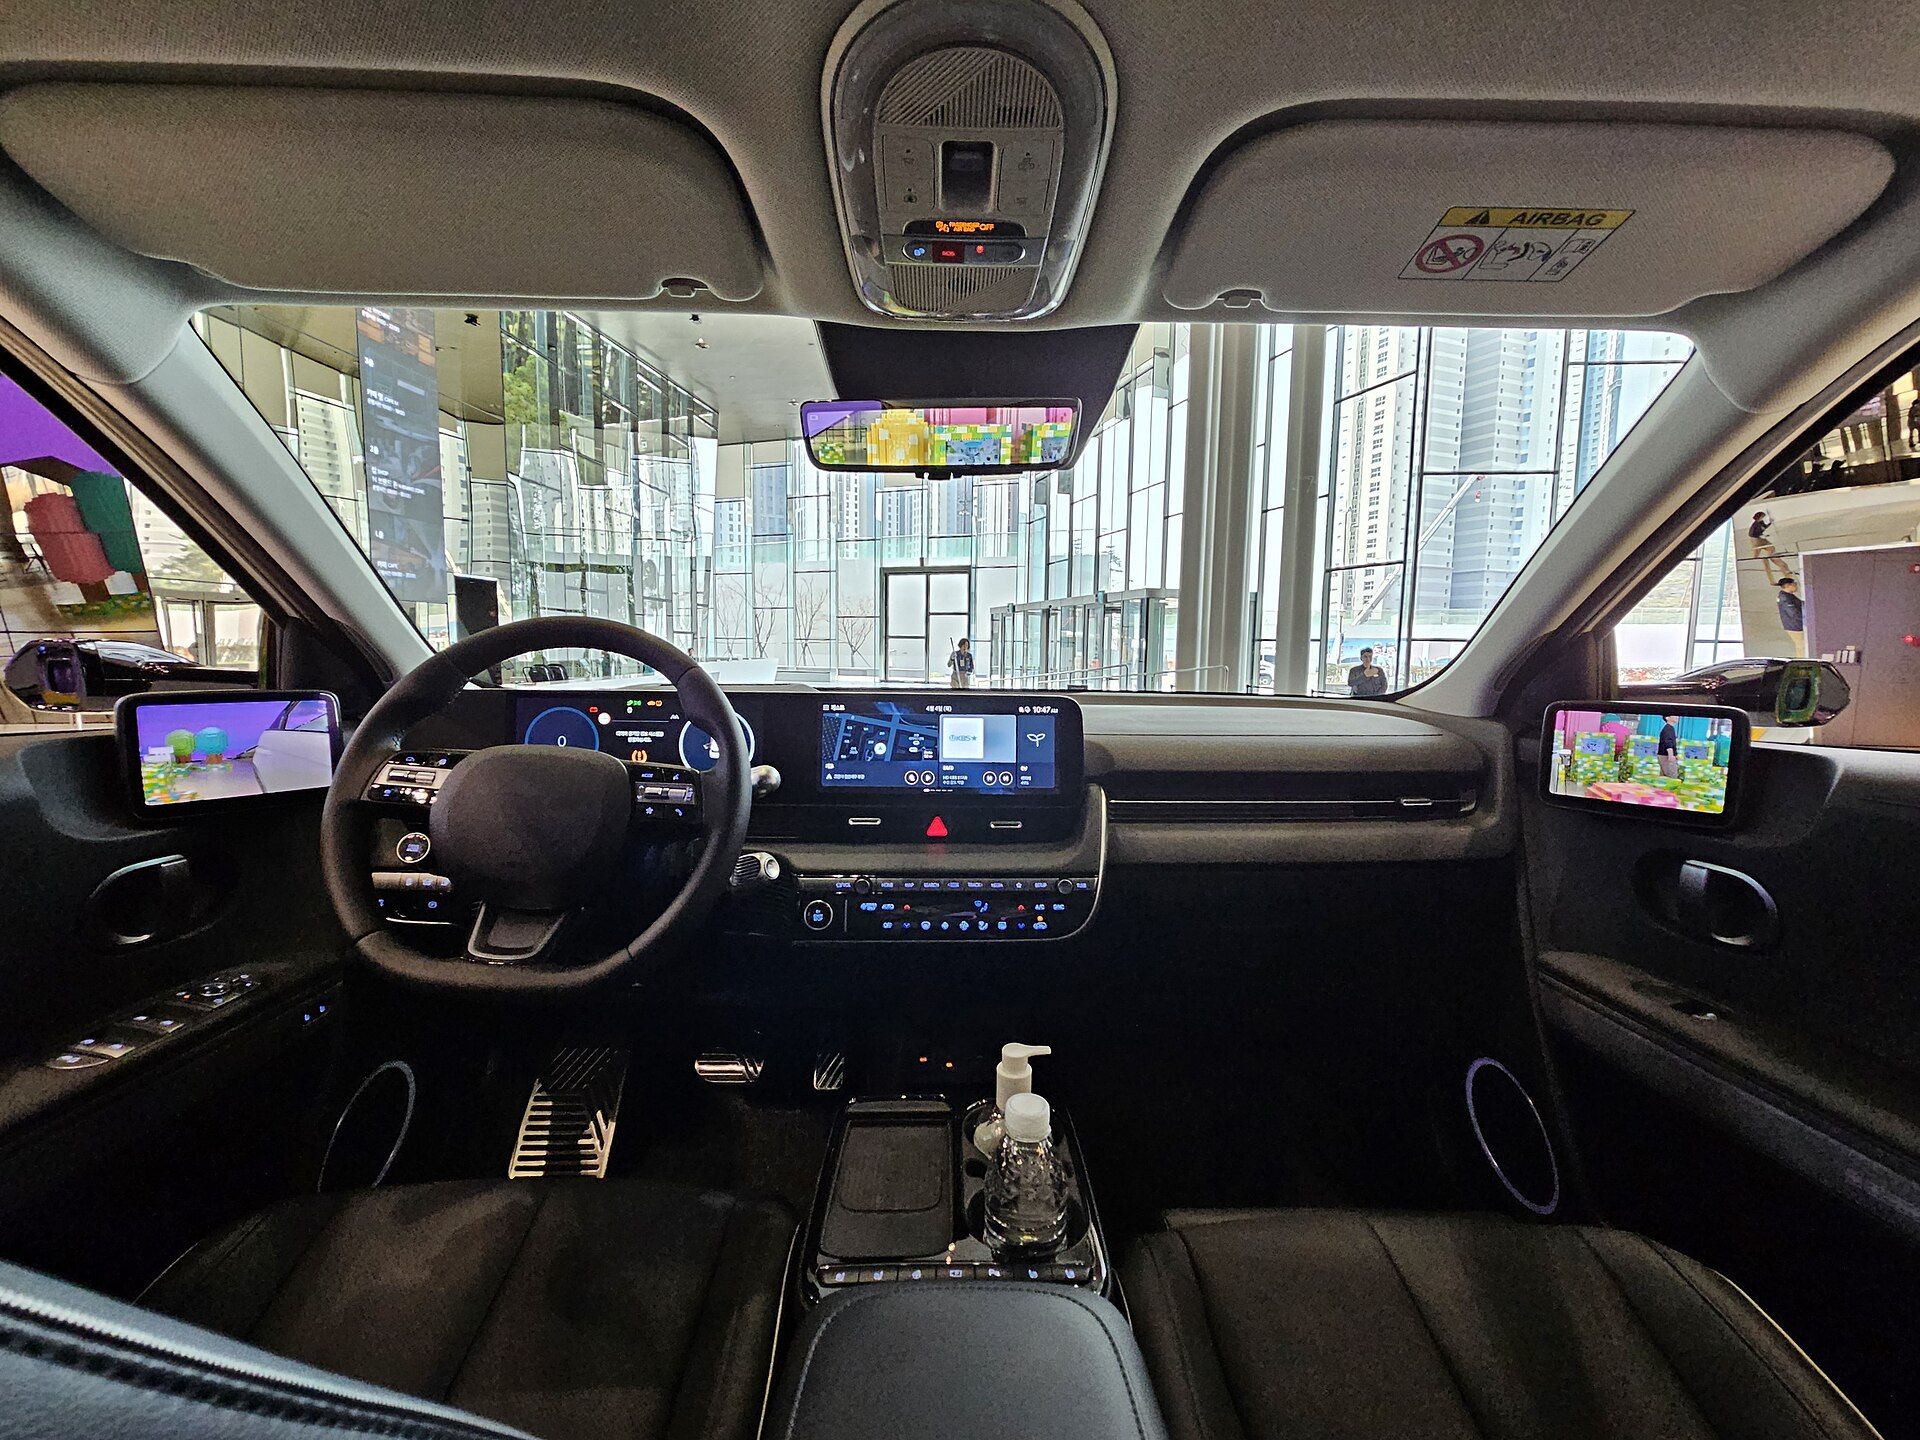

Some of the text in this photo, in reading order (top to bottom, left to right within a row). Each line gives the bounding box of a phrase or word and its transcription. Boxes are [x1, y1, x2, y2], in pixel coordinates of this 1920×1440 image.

[1507, 211, 1608, 227] AIRBAG
[1032, 706, 1051, 714] 10:47
[557, 735, 567, 747] 0
